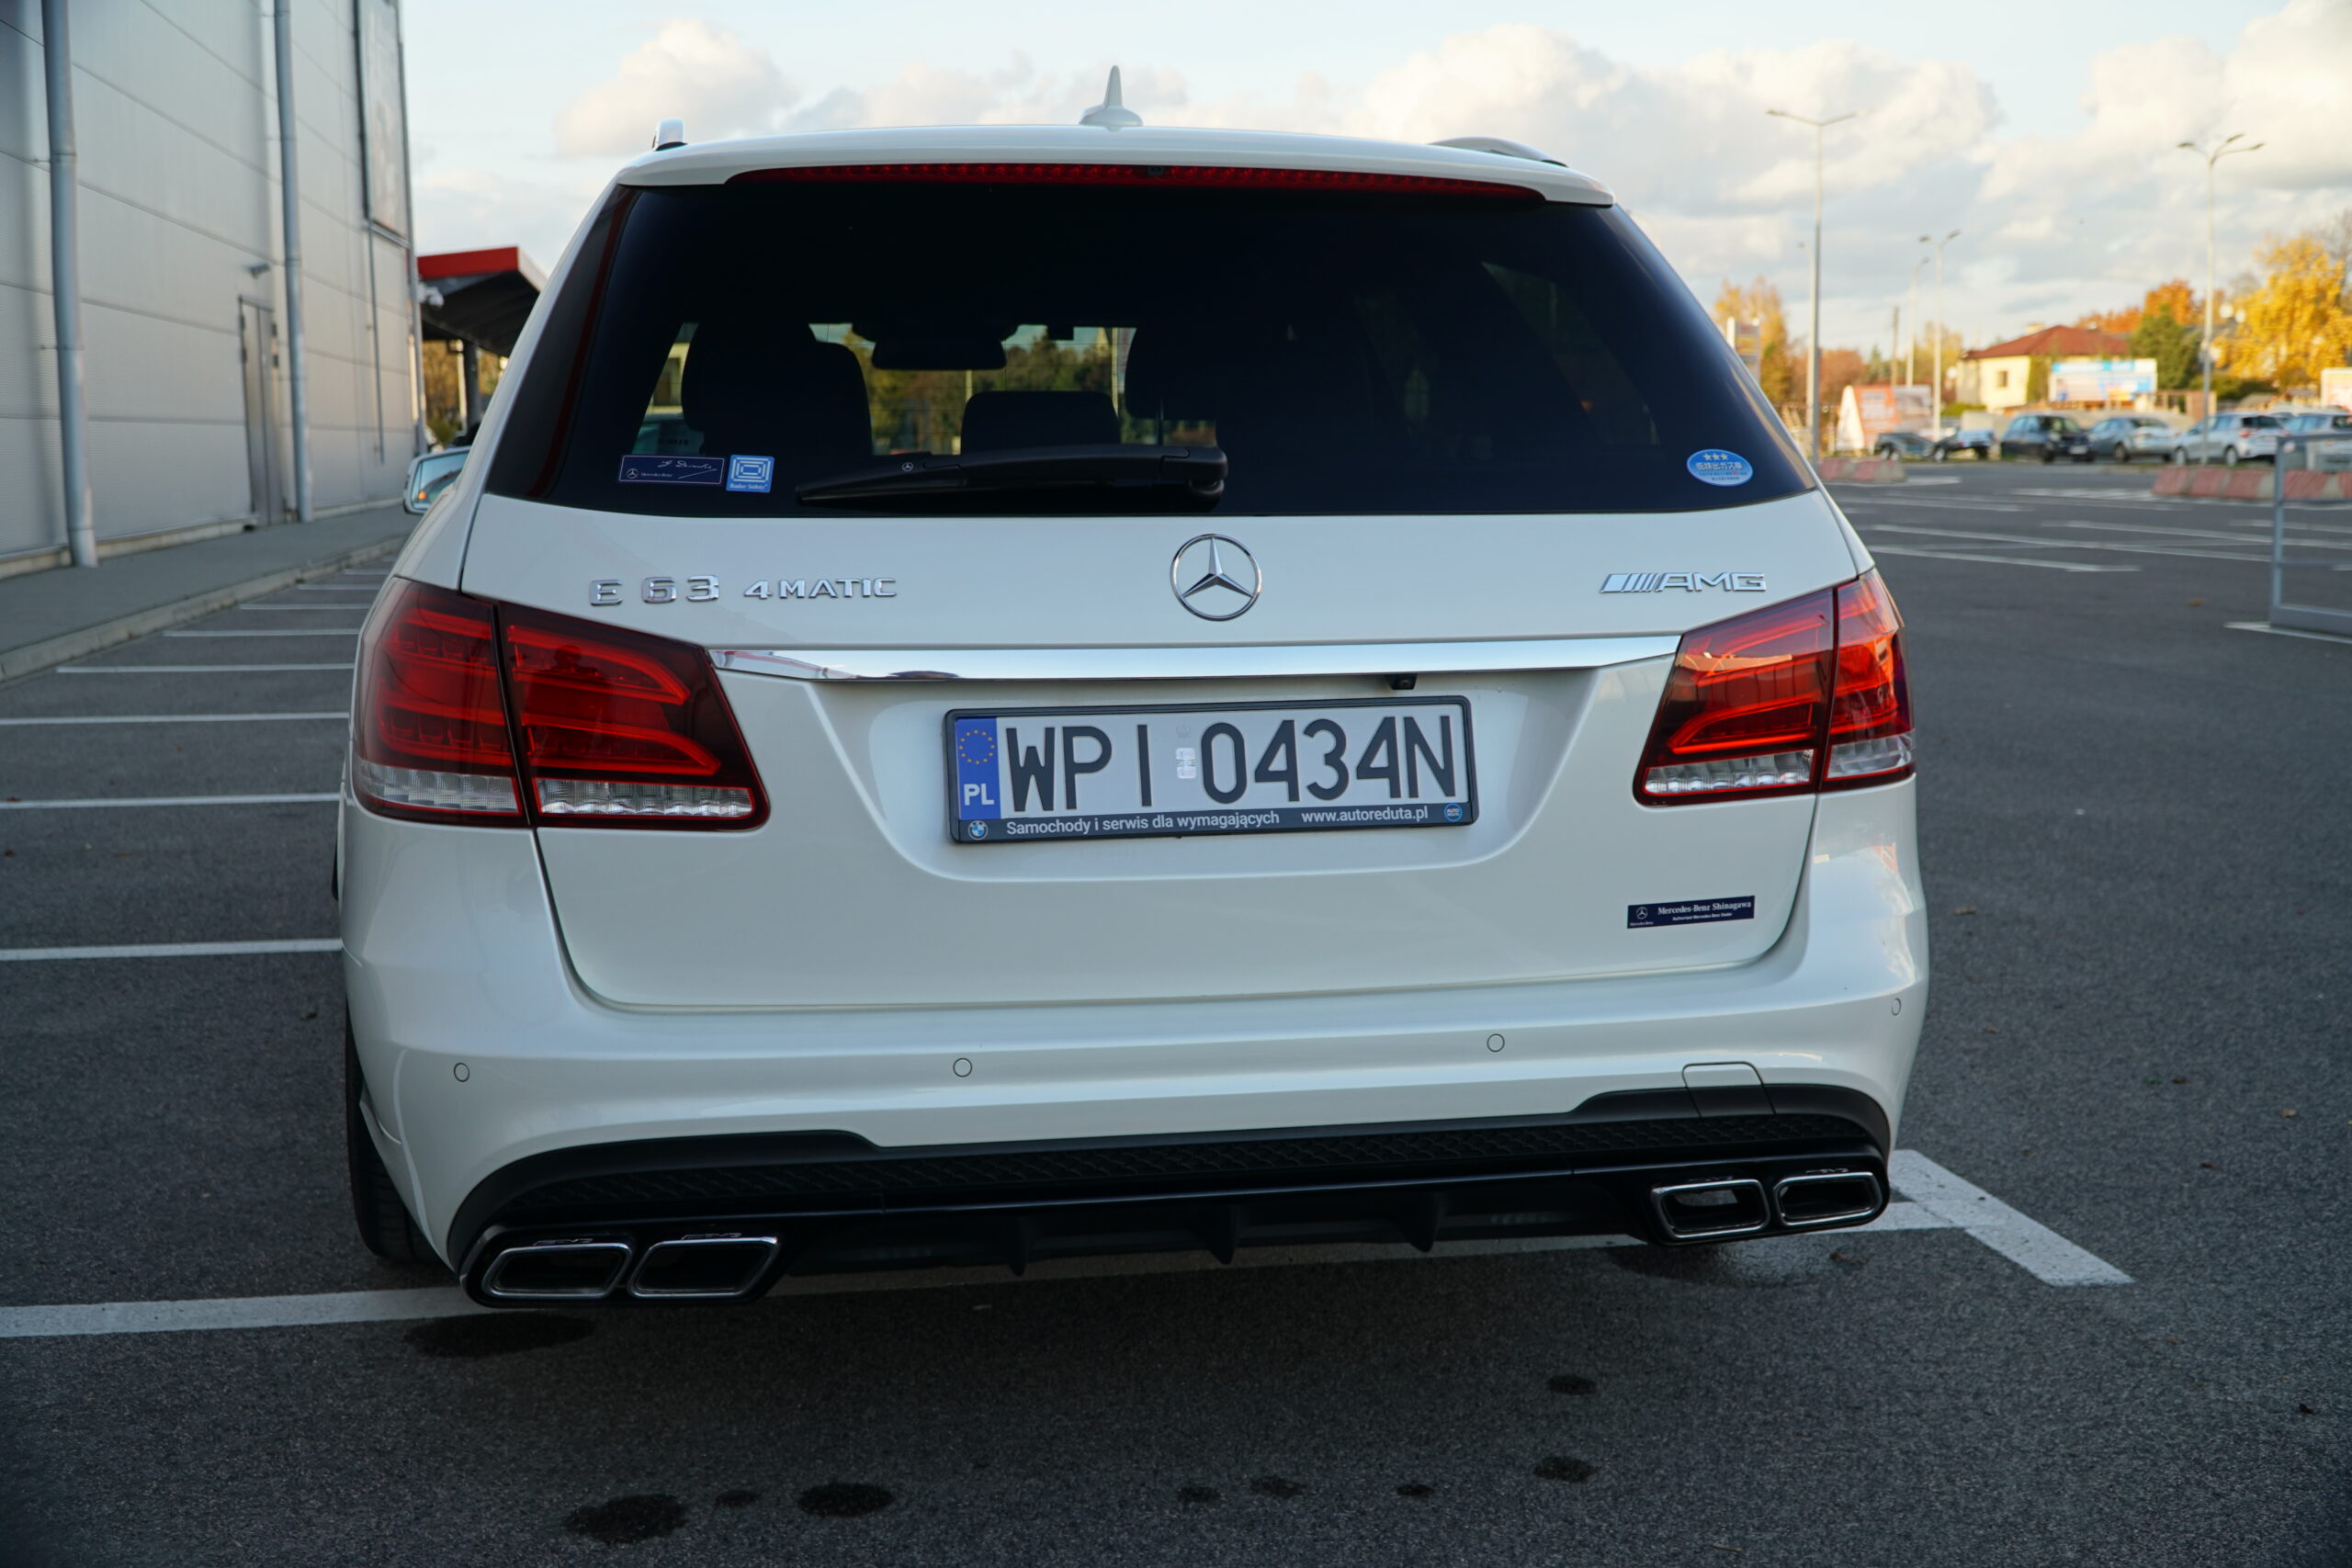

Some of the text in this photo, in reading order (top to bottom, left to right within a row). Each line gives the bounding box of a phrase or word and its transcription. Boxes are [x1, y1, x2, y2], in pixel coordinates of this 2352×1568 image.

[589, 574, 897, 606] E 63 4MATIC
[1200, 715, 1457, 805] 0434N
[963, 784, 995, 807] PL
[1006, 810, 1280, 835] Samochody i serwis dla wymagających
[1301, 806, 1429, 823] www.autoreduta.pl
[1657, 902, 1752, 915] Mercedes-Benz Shinagawa
